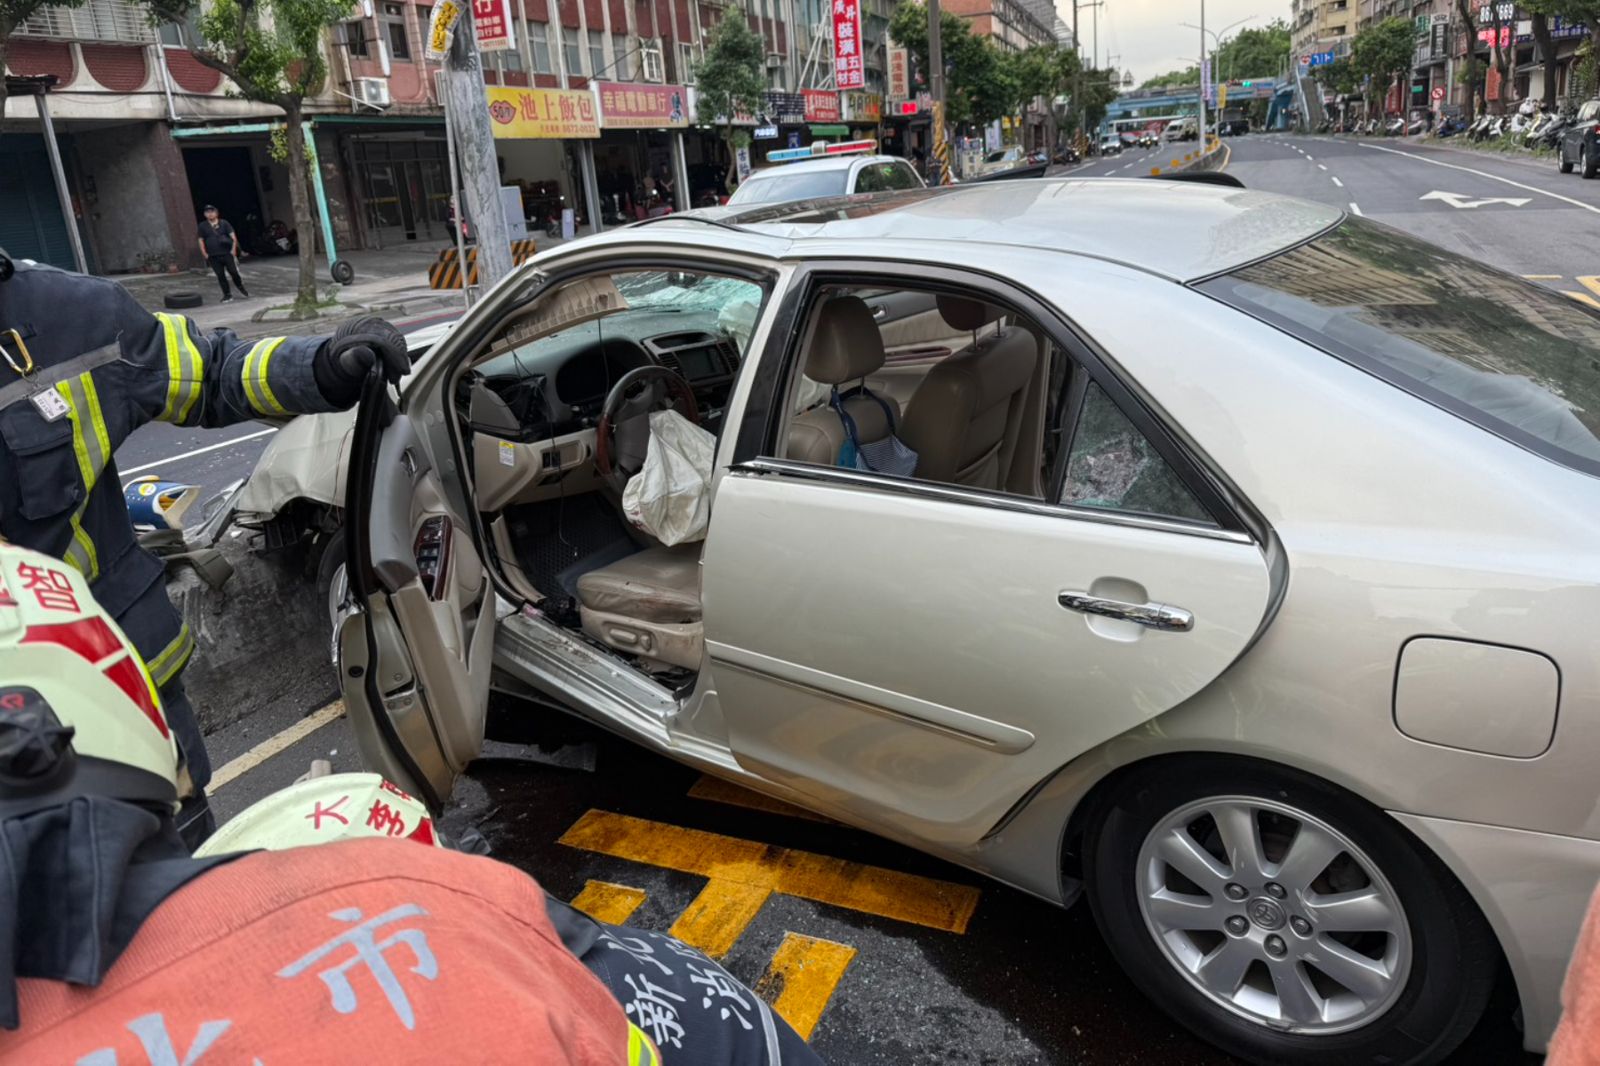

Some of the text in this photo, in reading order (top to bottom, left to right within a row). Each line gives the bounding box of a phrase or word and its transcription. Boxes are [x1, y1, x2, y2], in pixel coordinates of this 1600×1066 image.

[518, 93, 595, 122] 池上飯包
[16, 561, 82, 614] 智
[304, 795, 350, 830] 大
[273, 902, 439, 1031] 市
[598, 930, 687, 1049] 新北
